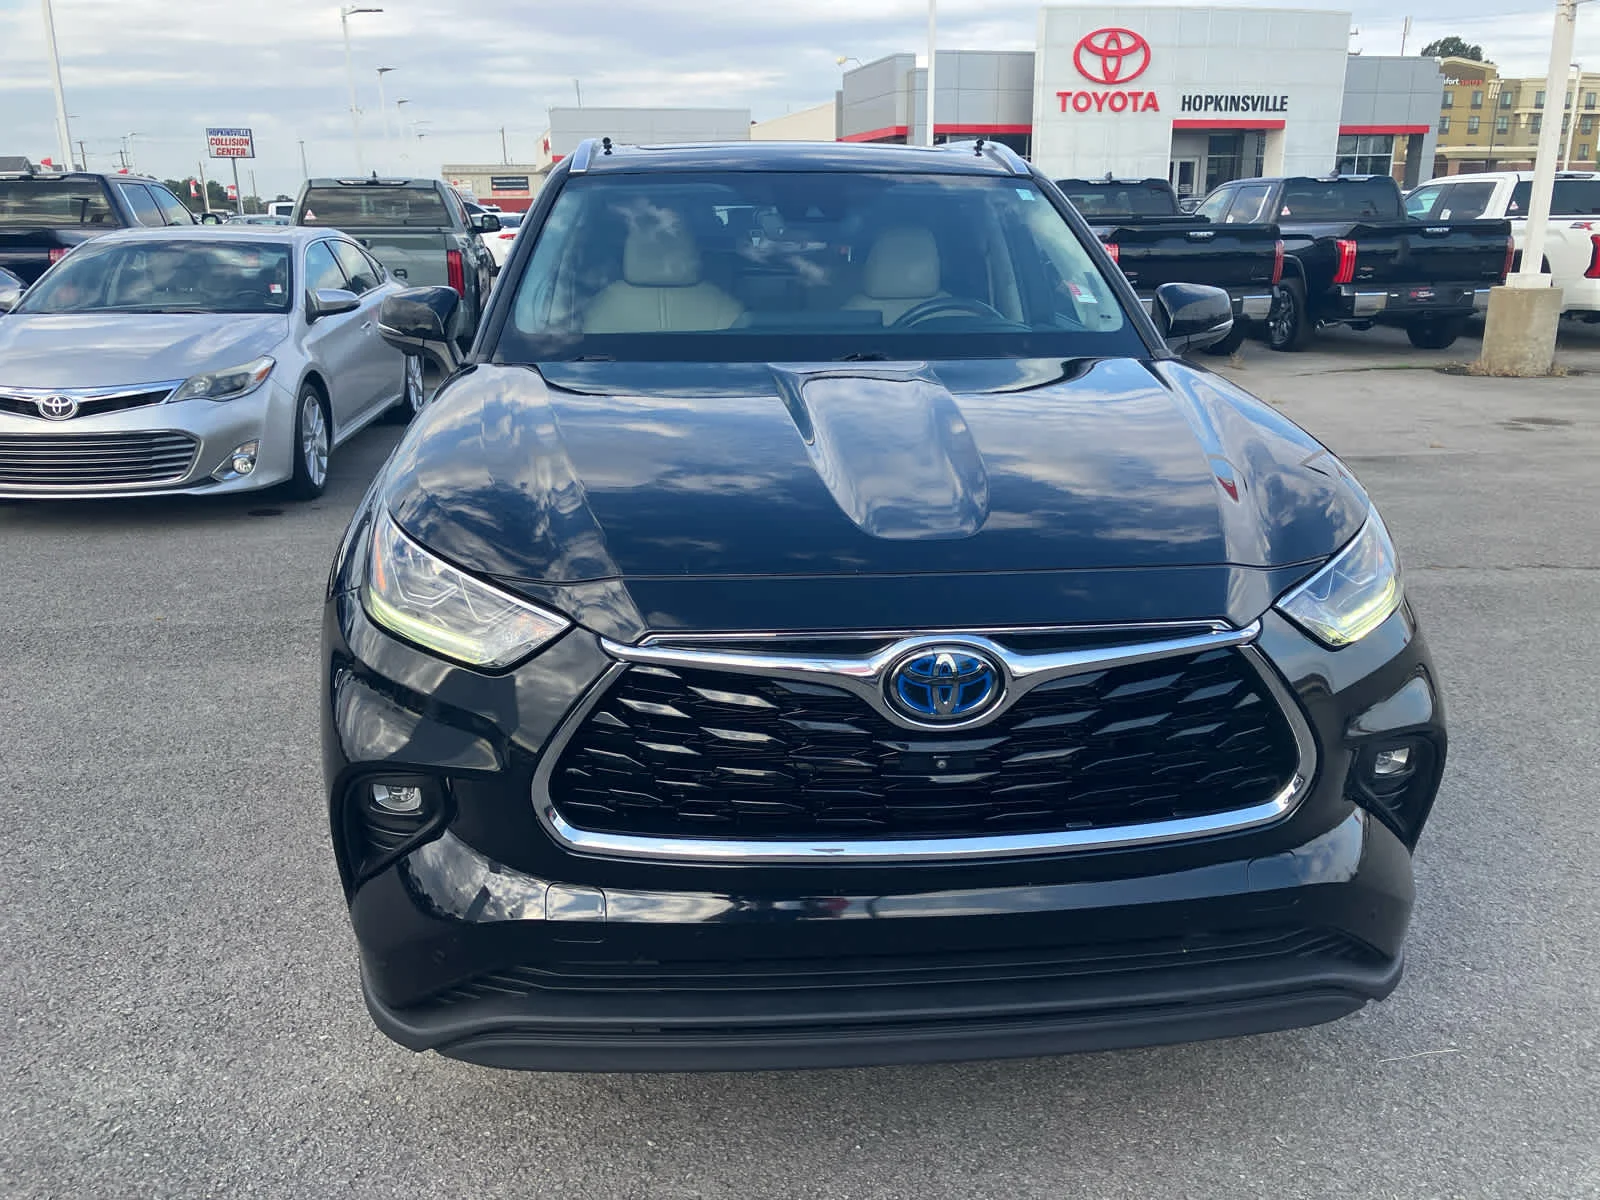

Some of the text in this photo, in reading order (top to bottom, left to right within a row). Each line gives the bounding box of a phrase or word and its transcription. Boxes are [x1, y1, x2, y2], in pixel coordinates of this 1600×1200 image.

[1056, 91, 1160, 113] TOYOTA
[1181, 94, 1289, 112] HOPKINSVILLE
[210, 137, 250, 146] COLLISION
[216, 147, 247, 156] CENTER
